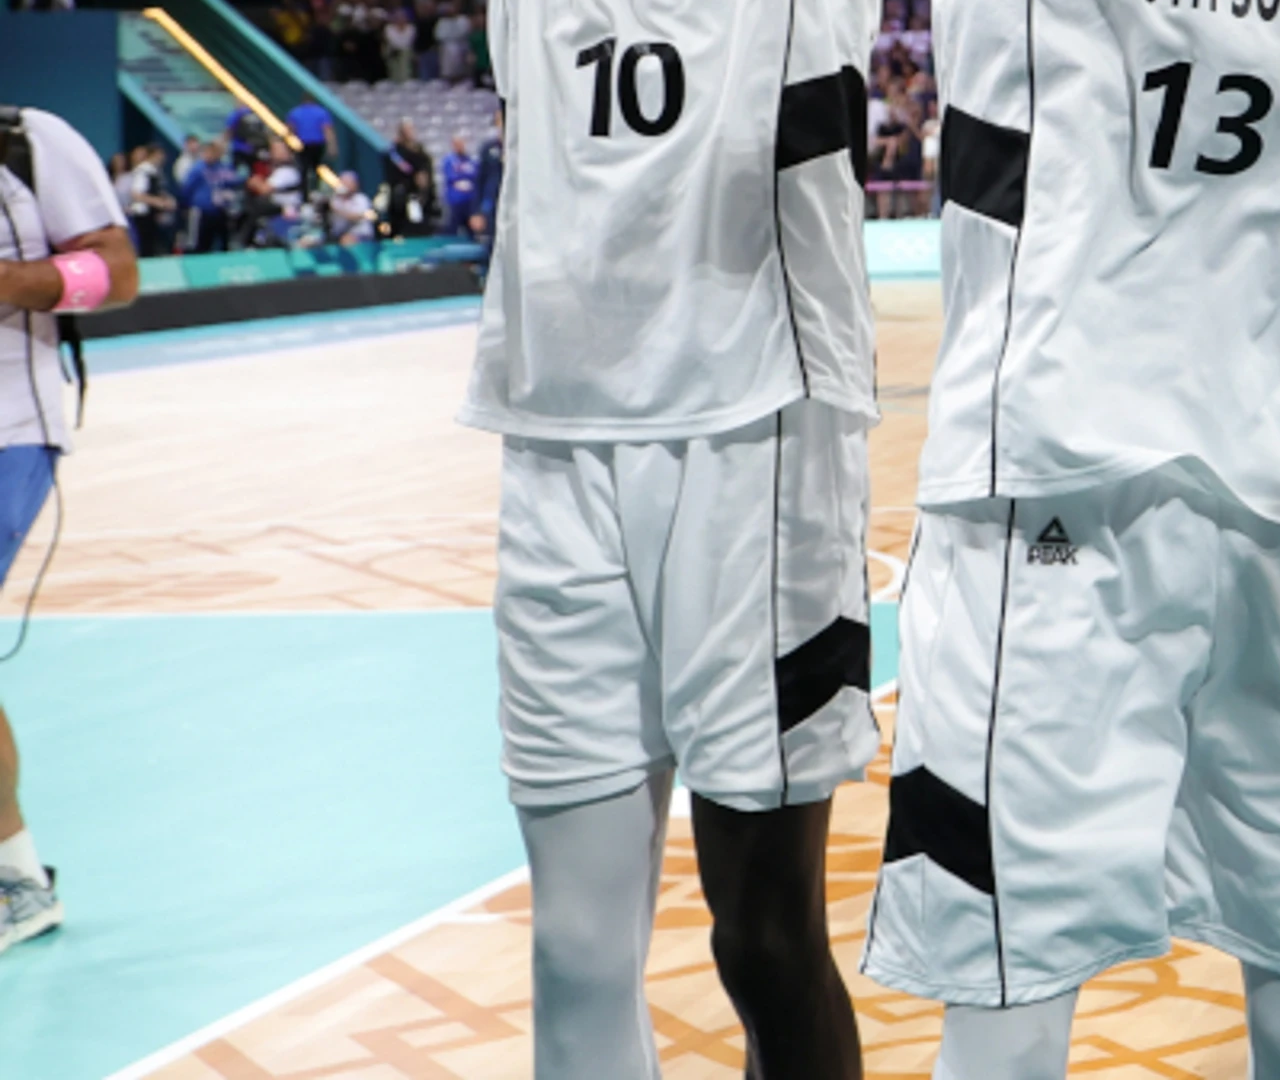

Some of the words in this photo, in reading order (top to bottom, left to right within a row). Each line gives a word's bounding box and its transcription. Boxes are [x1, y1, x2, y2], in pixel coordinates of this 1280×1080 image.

[575, 37, 685, 137] 10
[1142, 61, 1274, 176] 13
[1027, 545, 1078, 565] PEAK
